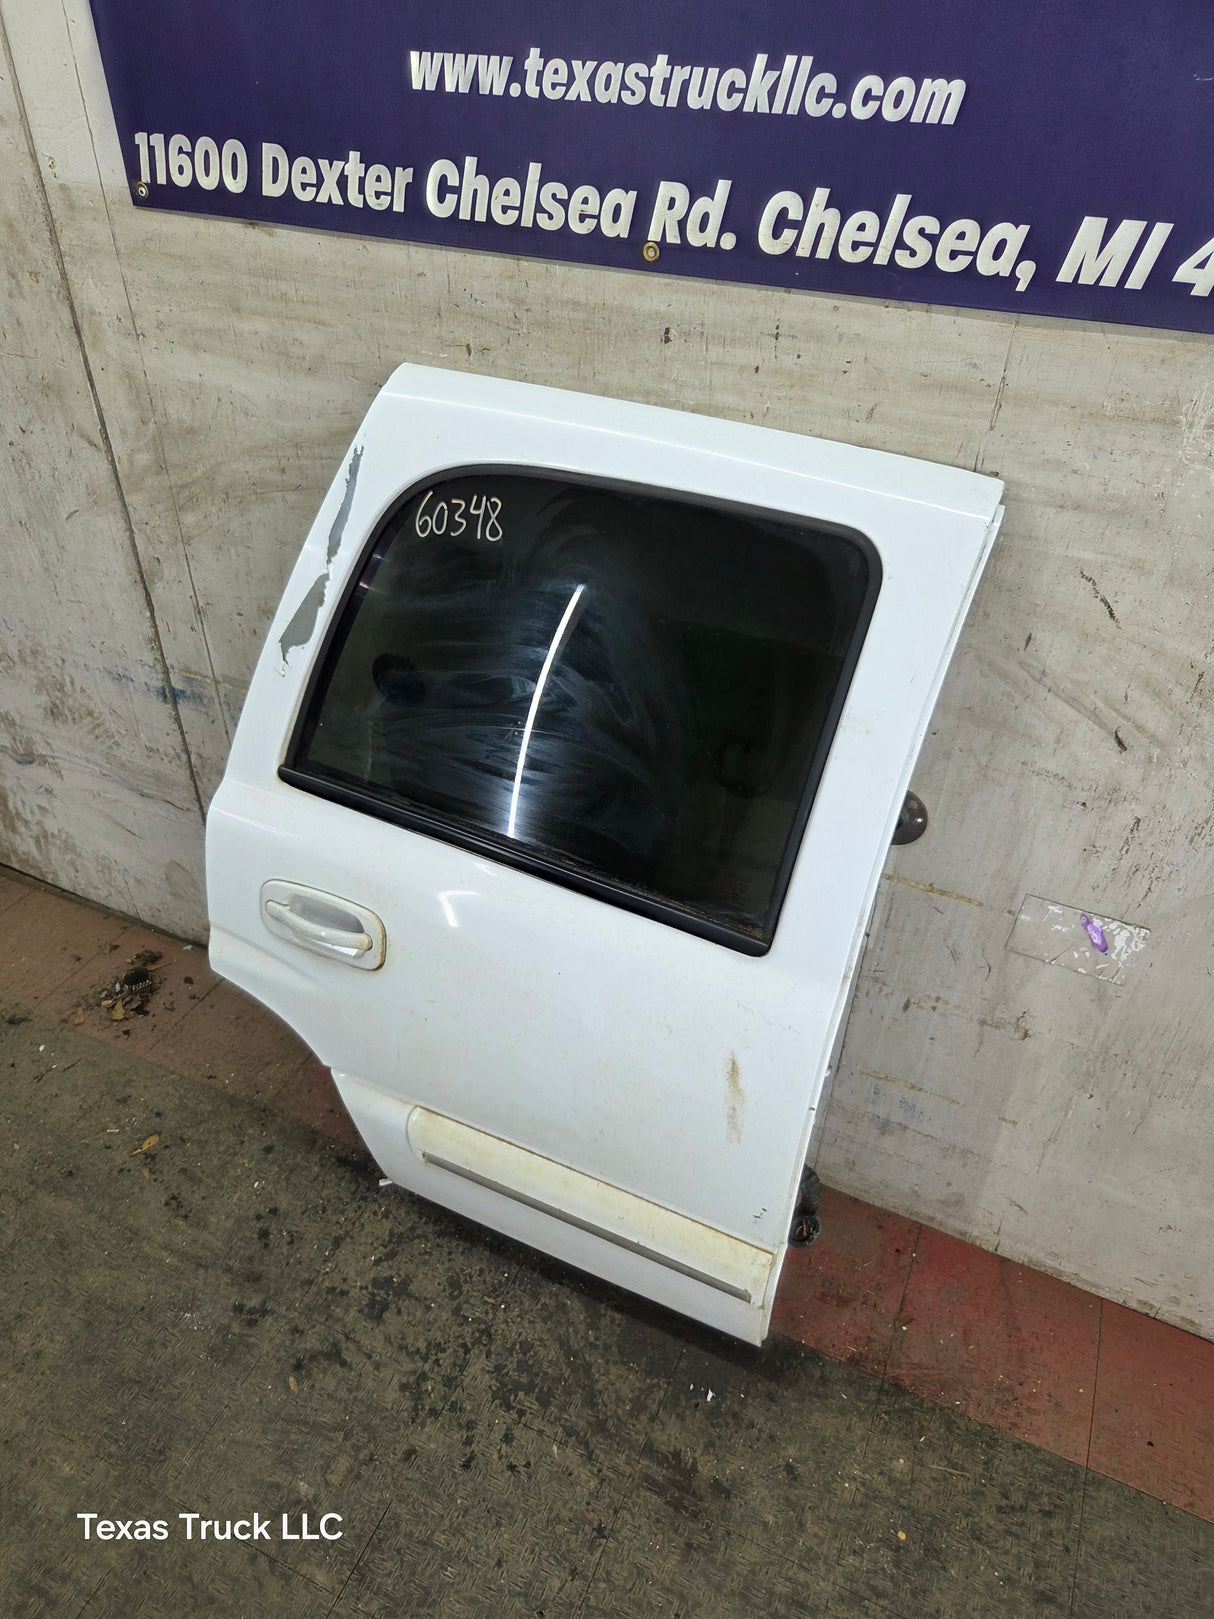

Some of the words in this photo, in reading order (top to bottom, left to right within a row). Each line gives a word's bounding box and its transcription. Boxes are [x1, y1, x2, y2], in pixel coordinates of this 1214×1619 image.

[409, 47, 967, 126] www.texastruckllc.com
[134, 131, 249, 194] 11600
[261, 142, 414, 213] Dexter
[425, 156, 638, 240] Chelsea
[647, 179, 737, 252] Rd.
[757, 187, 1038, 293] Chelsea,
[1055, 215, 1175, 291] MI
[415, 490, 503, 542] 60348
